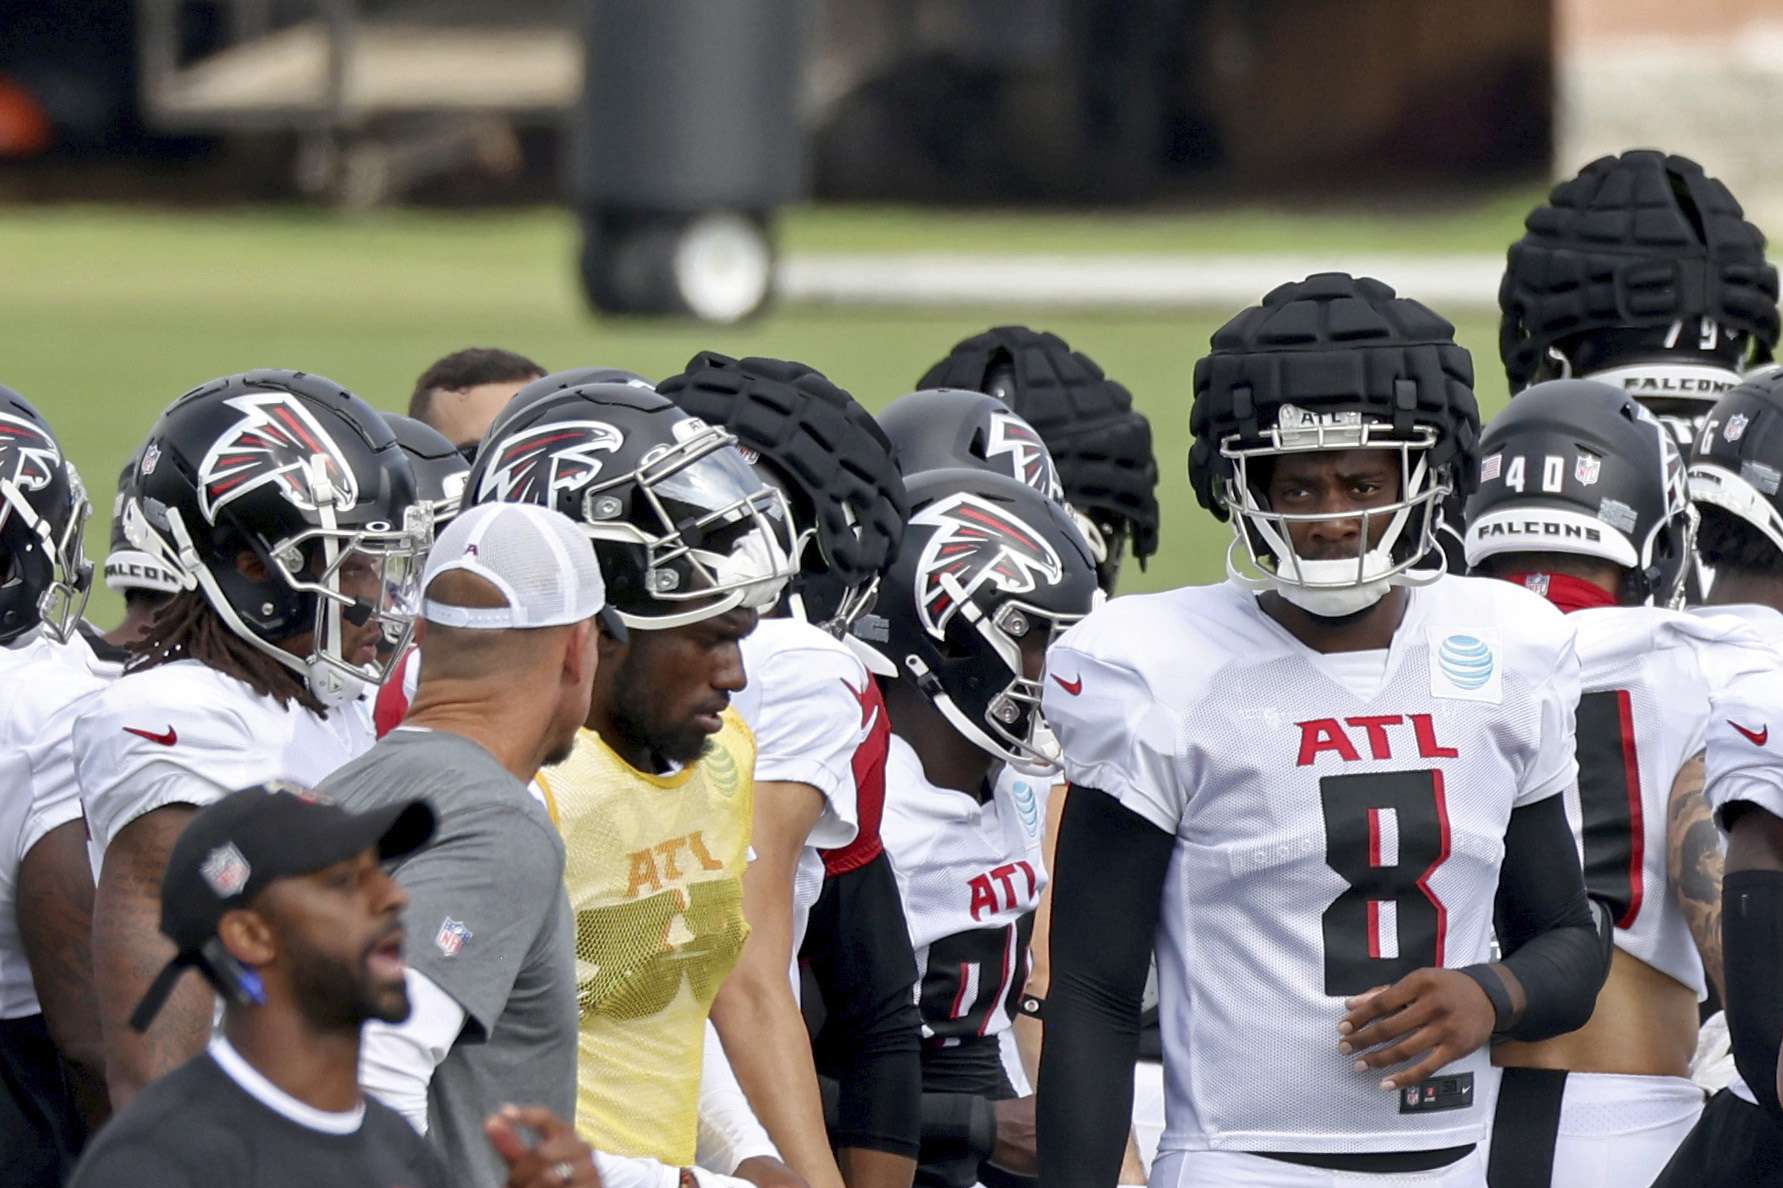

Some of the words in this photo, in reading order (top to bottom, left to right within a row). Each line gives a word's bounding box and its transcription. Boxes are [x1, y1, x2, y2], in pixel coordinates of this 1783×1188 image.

[1300, 411, 1343, 426] ATL
[1505, 455, 1565, 493] 40
[1478, 521, 1602, 544] FALCONS
[1292, 713, 1460, 768] ATL
[622, 829, 724, 900] ATL
[1317, 767, 1450, 998] 8
